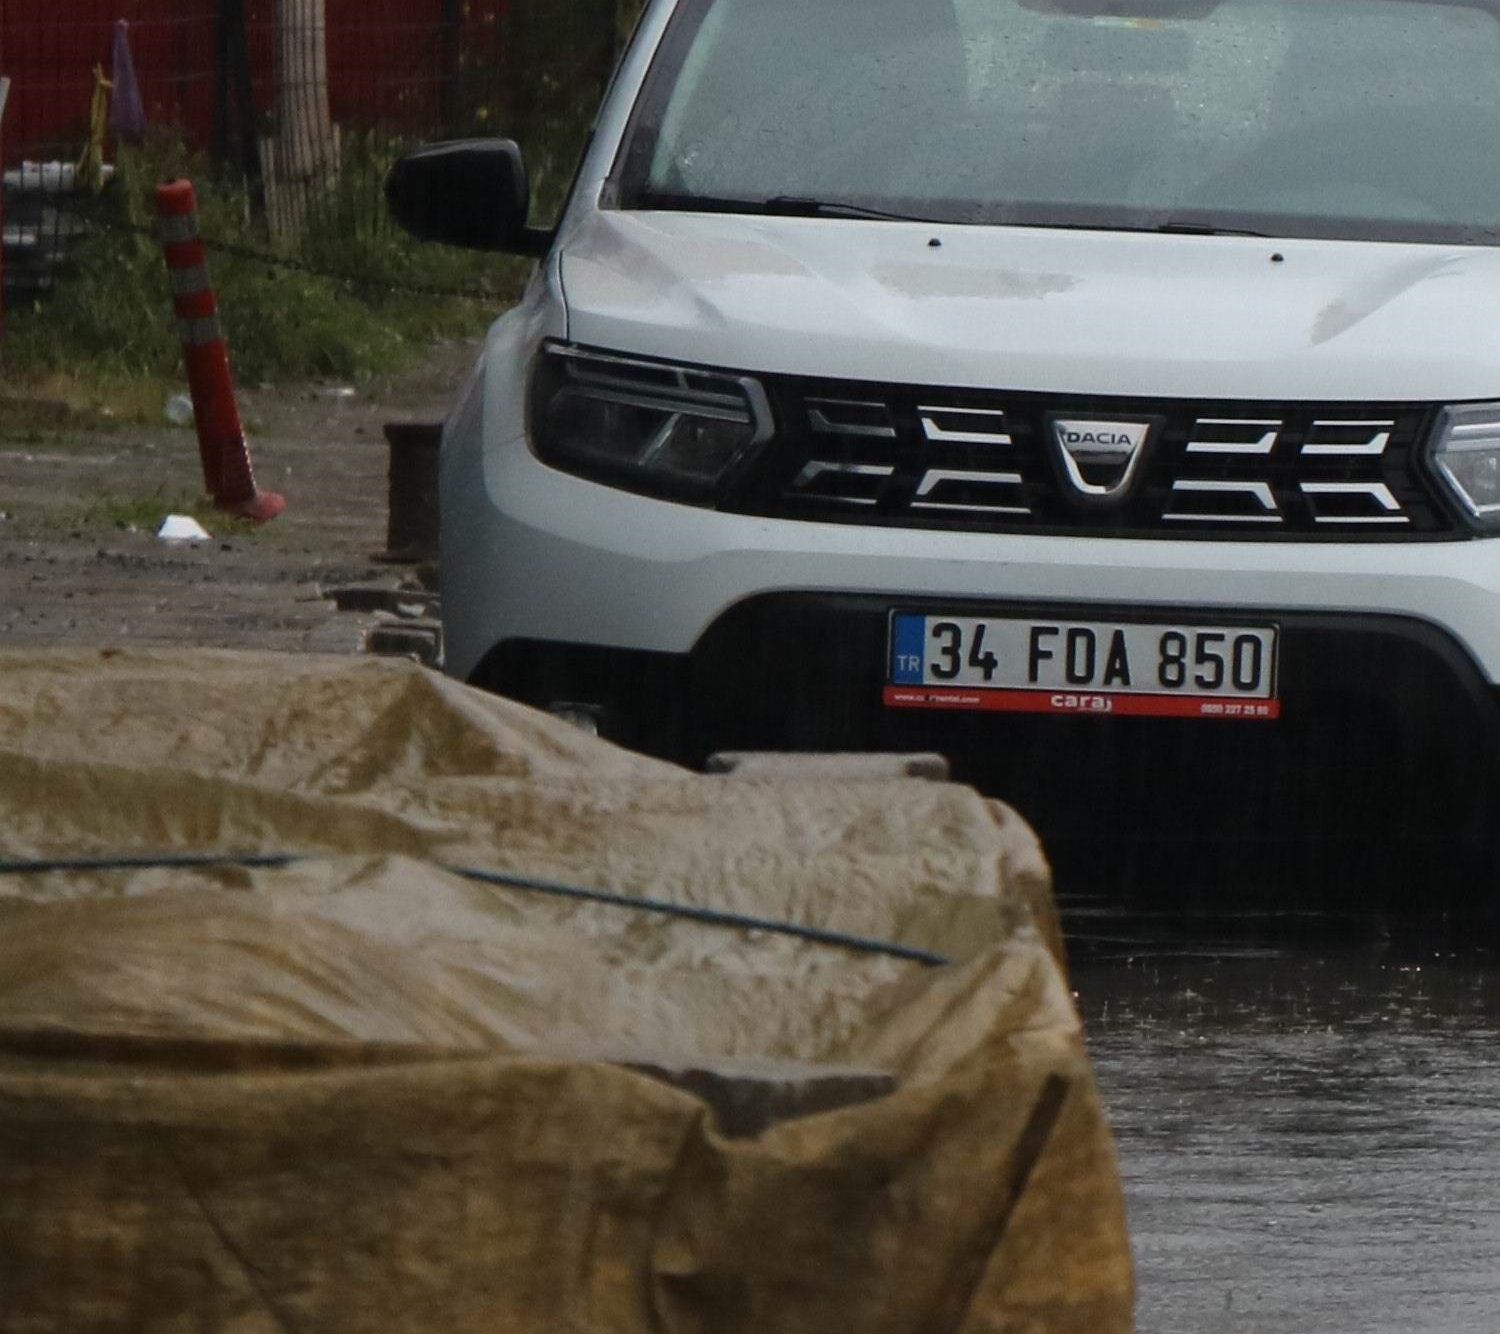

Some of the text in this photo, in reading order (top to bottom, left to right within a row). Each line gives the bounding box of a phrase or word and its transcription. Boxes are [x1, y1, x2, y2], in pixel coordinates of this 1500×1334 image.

[1066, 432, 1132, 445] DACIA
[897, 621, 1264, 692] TR 34 FDA 850
